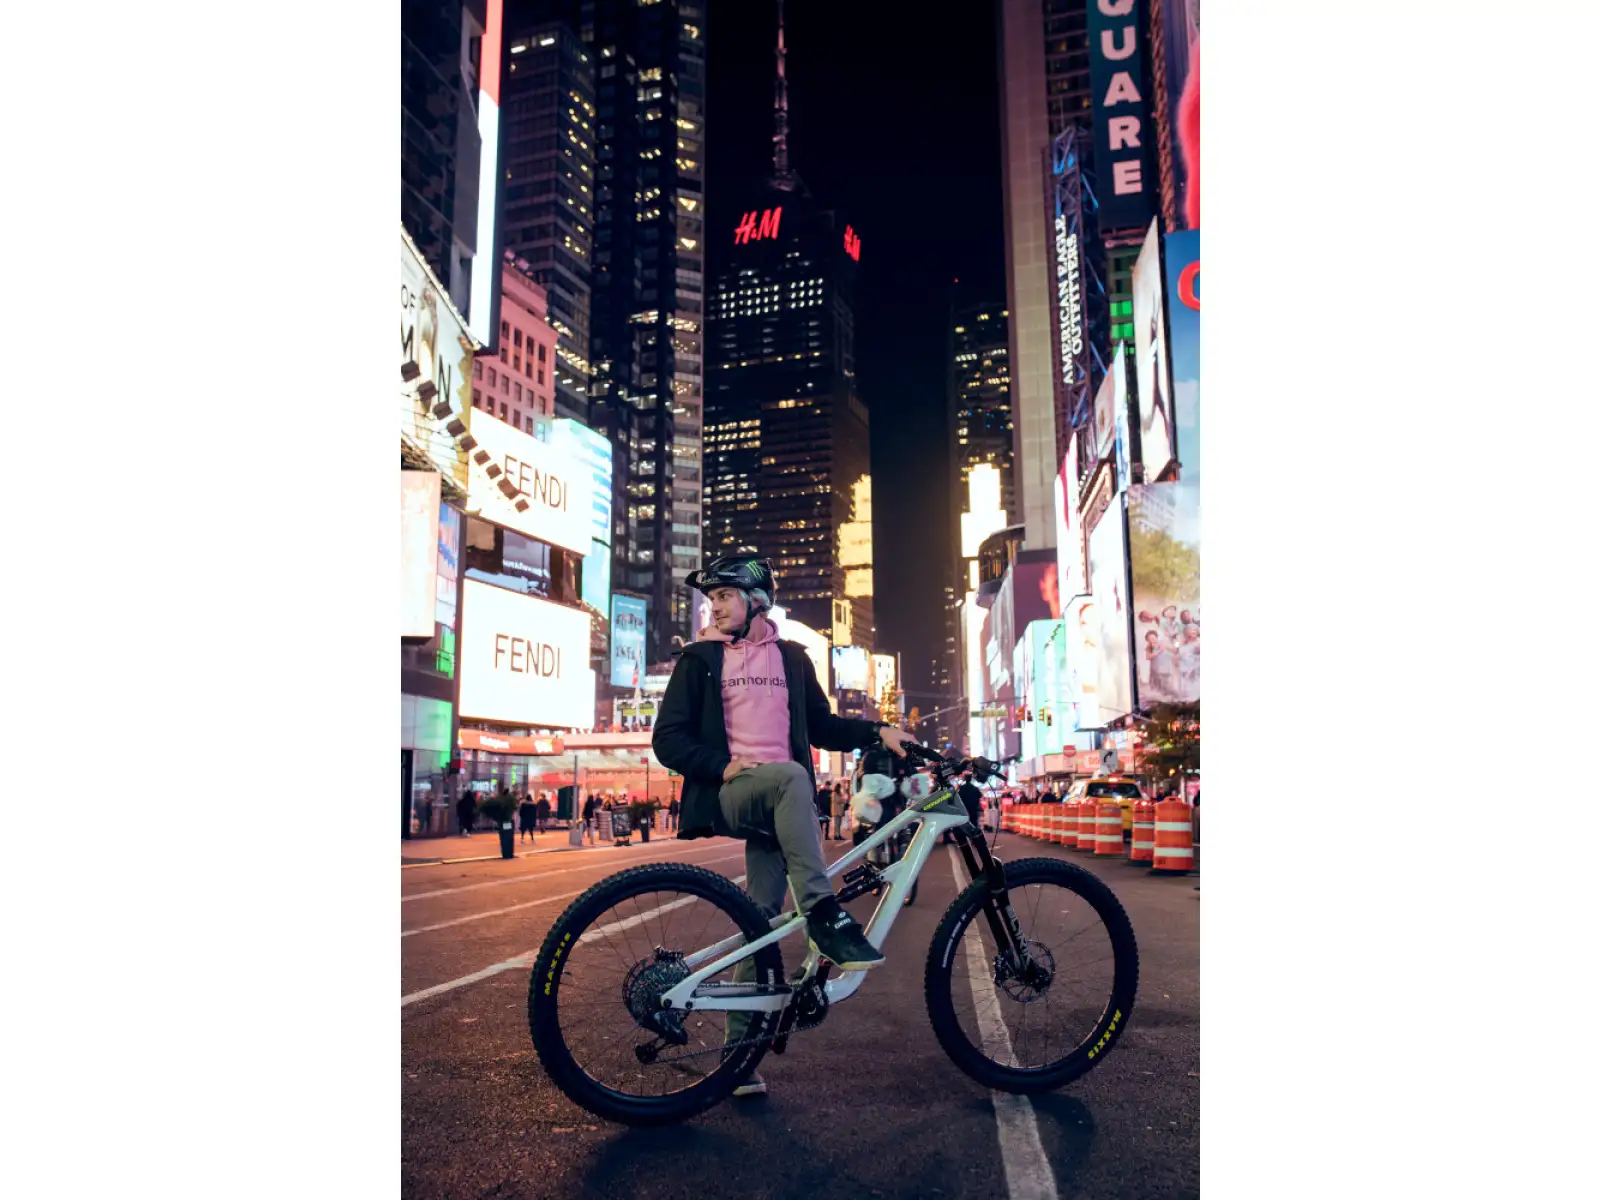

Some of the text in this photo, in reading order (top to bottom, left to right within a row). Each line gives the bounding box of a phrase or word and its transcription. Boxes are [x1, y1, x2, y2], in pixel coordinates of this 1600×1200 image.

[734, 205, 783, 245] H&M
[401, 283, 417, 315] OF
[1054, 213, 1074, 385] AMERICAN EAGLE
[1066, 232, 1083, 355] OUTFITTERS
[504, 454, 568, 513] FENDI
[494, 632, 561, 680] FENDI
[720, 676, 788, 689] cannonda
[544, 932, 571, 997] MAXXIS
[1087, 1008, 1122, 1060] MAXXIS
